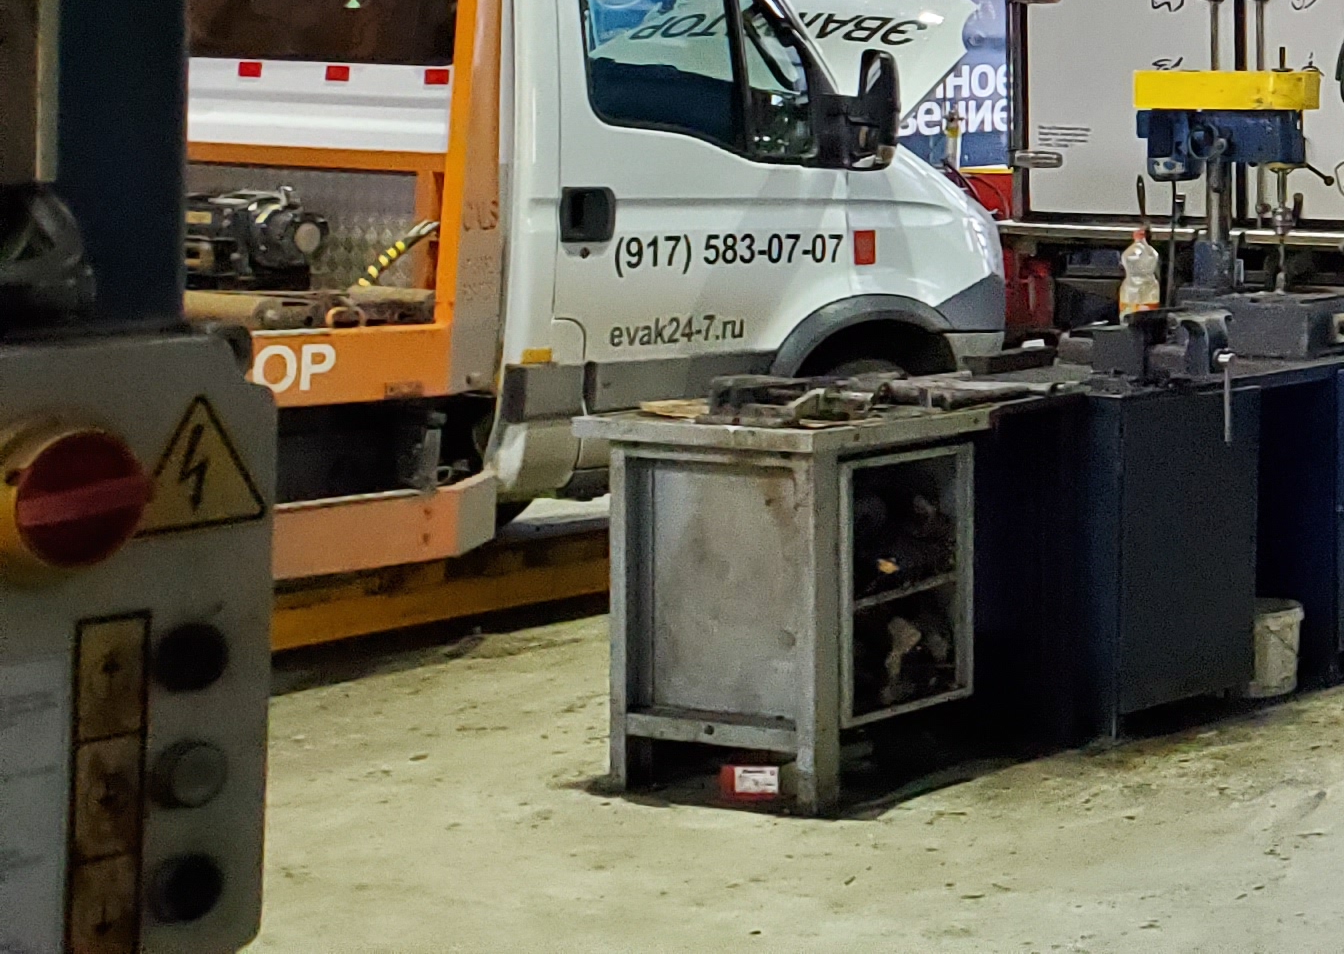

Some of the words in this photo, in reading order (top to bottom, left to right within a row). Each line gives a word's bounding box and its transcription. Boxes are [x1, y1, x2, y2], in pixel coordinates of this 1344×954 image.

[614, 233, 692, 278] (917)
[703, 233, 844, 265] 583-07-07
[609, 314, 745, 347] evak24-7.ru
